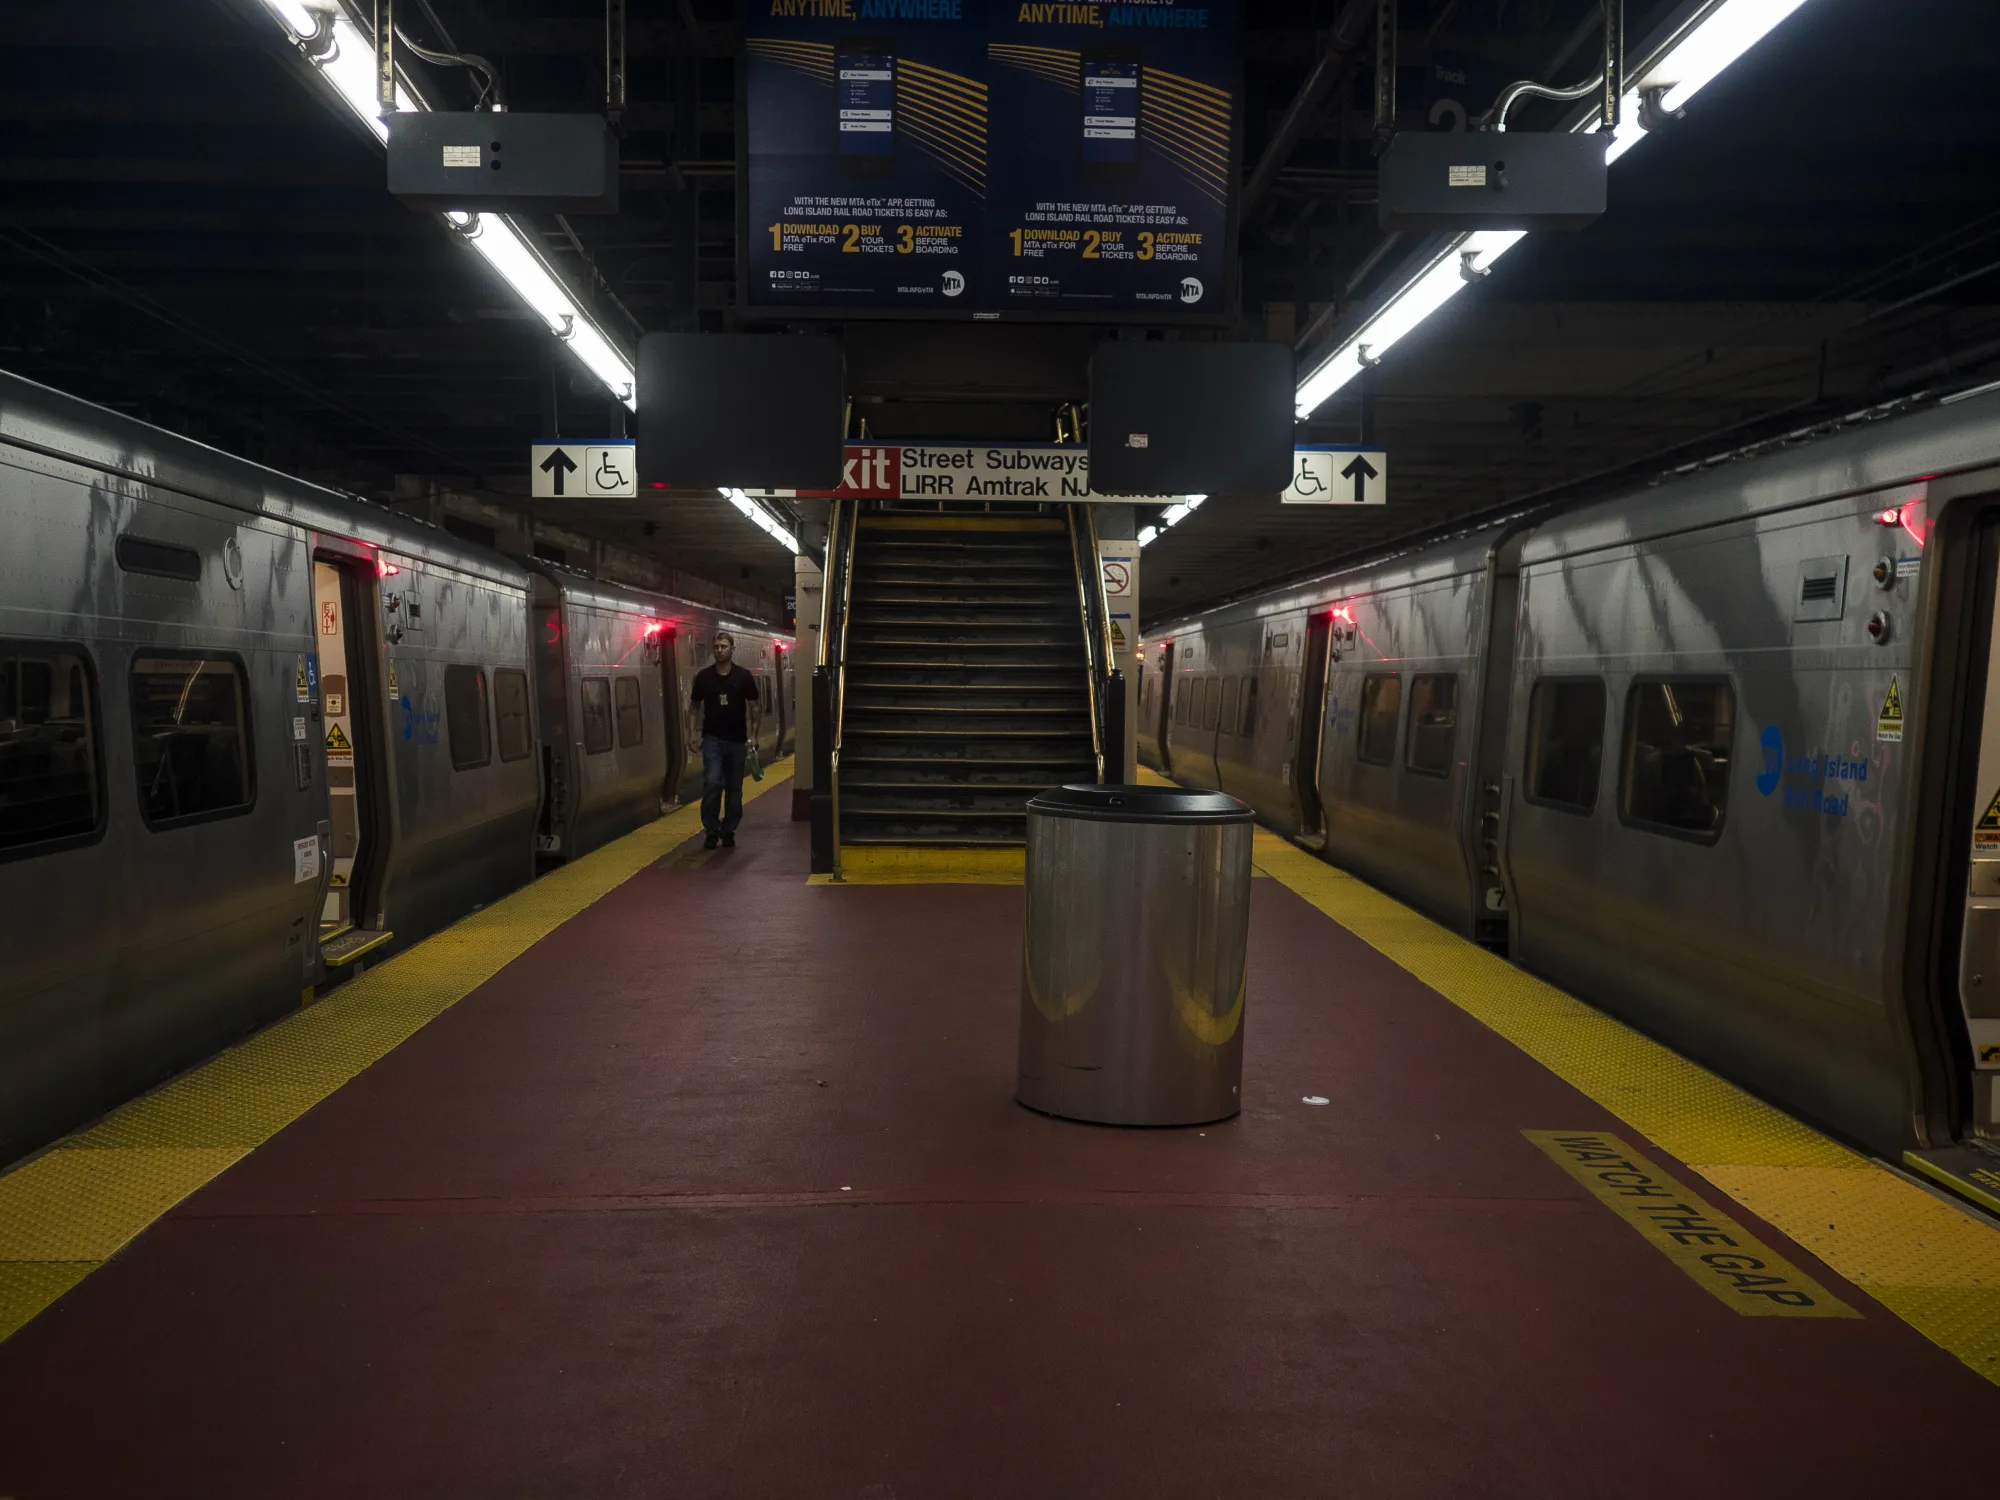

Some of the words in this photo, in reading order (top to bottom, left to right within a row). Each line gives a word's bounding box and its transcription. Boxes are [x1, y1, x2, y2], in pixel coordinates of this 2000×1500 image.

[771, 0, 856, 20] ANYTIME,
[861, 0, 963, 19] ANYWHERE
[1018, 4, 1103, 28] ANYTIME,
[1108, 6, 1209, 28] ANYWHERE
[794, 197, 815, 206] WITH
[816, 197, 829, 206] THE
[830, 198, 848, 206] NEW
[849, 198, 865, 207] MTA
[888, 199, 903, 208] APP,
[904, 199, 935, 207] GETTING
[1036, 202, 1055, 211] WITH
[1057, 203, 1071, 212] THE
[1072, 203, 1089, 212] NEW
[1090, 203, 1107, 213] MTA
[1129, 205, 1145, 214] APP,
[1146, 205, 1177, 214] GETTING
[783, 207, 804, 216] LONG
[805, 207, 832, 216] ISLAND
[833, 208, 850, 216] RAIL
[852, 208, 872, 217] ROAD
[874, 208, 904, 217] TICKETS
[906, 209, 913, 217] IS
[915, 209, 933, 218] EASY
[935, 209, 947, 218] AS:
[1025, 212, 1045, 221] LONG
[1046, 212, 1073, 221] ISLAND
[1075, 213, 1092, 222] RAIL
[1093, 213, 1113, 223] ROAD
[1115, 214, 1145, 223] TICKETS
[1147, 215, 1154, 223] IS
[1156, 215, 1174, 224] EASY
[1176, 216, 1188, 224] AS:
[769, 223, 781, 251] 1
[783, 224, 839, 236] DOWNLOAD
[818, 236, 836, 244] FOR
[842, 224, 860, 253] 2
[861, 224, 881, 236] BUY
[861, 236, 884, 244] YOUR
[896, 224, 914, 254] 3
[916, 226, 963, 237] ACTIVATE
[916, 237, 948, 245] BEFORE
[1010, 228, 1022, 257] 1
[1024, 229, 1080, 241] DOWNLOAD
[783, 244, 804, 252] FREE
[861, 245, 894, 253] TICKETS
[916, 246, 958, 254] BOARDING
[1024, 241, 1040, 249] MTA
[1042, 241, 1058, 249] eTix
[1082, 230, 1100, 259] 2
[1101, 231, 1122, 242] BUY
[1137, 231, 1154, 260] 3
[1156, 233, 1202, 244] ACTIVATE
[1156, 244, 1188, 252] BEFORE
[1024, 249, 1044, 257] FREE
[1101, 251, 1134, 259] TICKETS
[1155, 253, 1198, 261] BOARDING
[844, 449, 891, 490] xit
[902, 449, 974, 469] Street
[986, 449, 1088, 474] Subways
[902, 475, 954, 495] LIRR
[966, 476, 1048, 496] Amtrak
[1061, 477, 1090, 497] NJ
[1824, 754, 1868, 781] Island
[1814, 789, 1849, 816] Road
[1553, 1136, 1673, 1197] WATCH
[1637, 1203, 1740, 1247] THE
[1699, 1253, 1815, 1307] GAP
